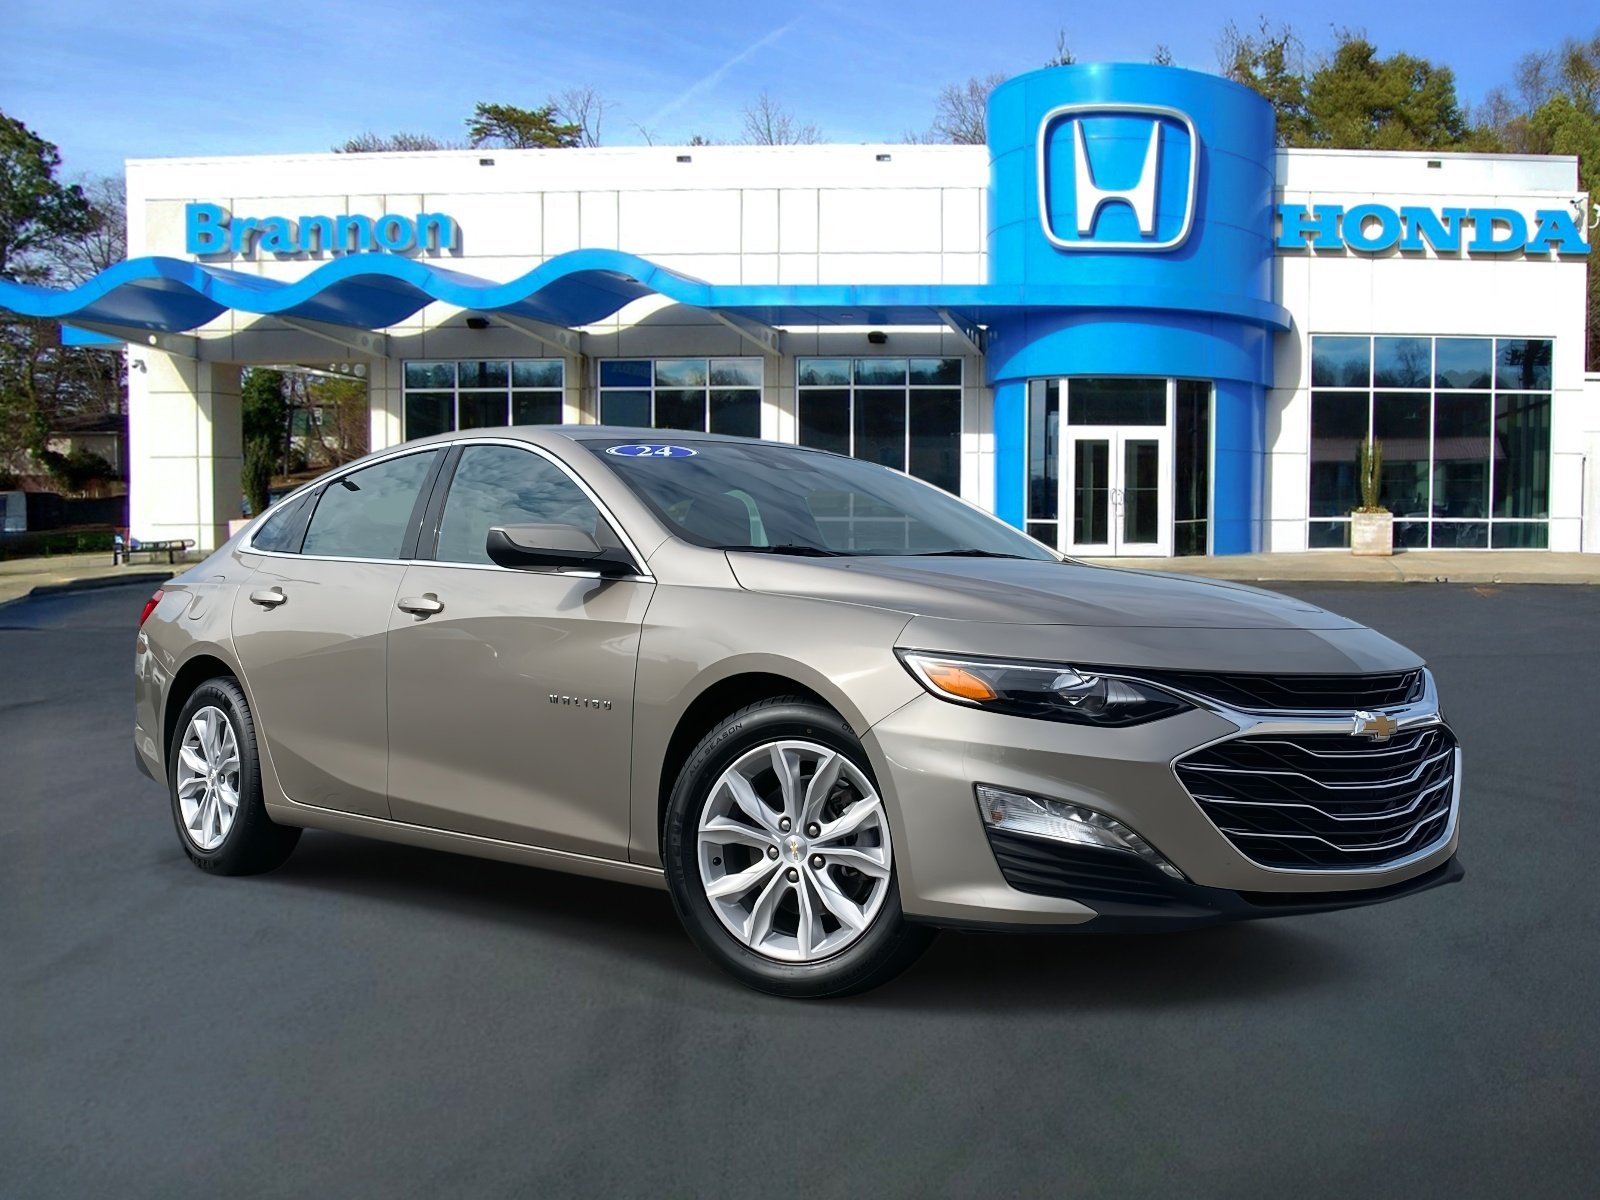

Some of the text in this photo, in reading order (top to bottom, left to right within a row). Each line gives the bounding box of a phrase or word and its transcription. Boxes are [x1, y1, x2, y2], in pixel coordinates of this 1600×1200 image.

[185, 203, 459, 254] Brannon
[1277, 203, 1591, 254] HONDA
[635, 446, 673, 457] 24
[549, 694, 612, 711] MALIBU
[704, 722, 743, 756] SEASON
